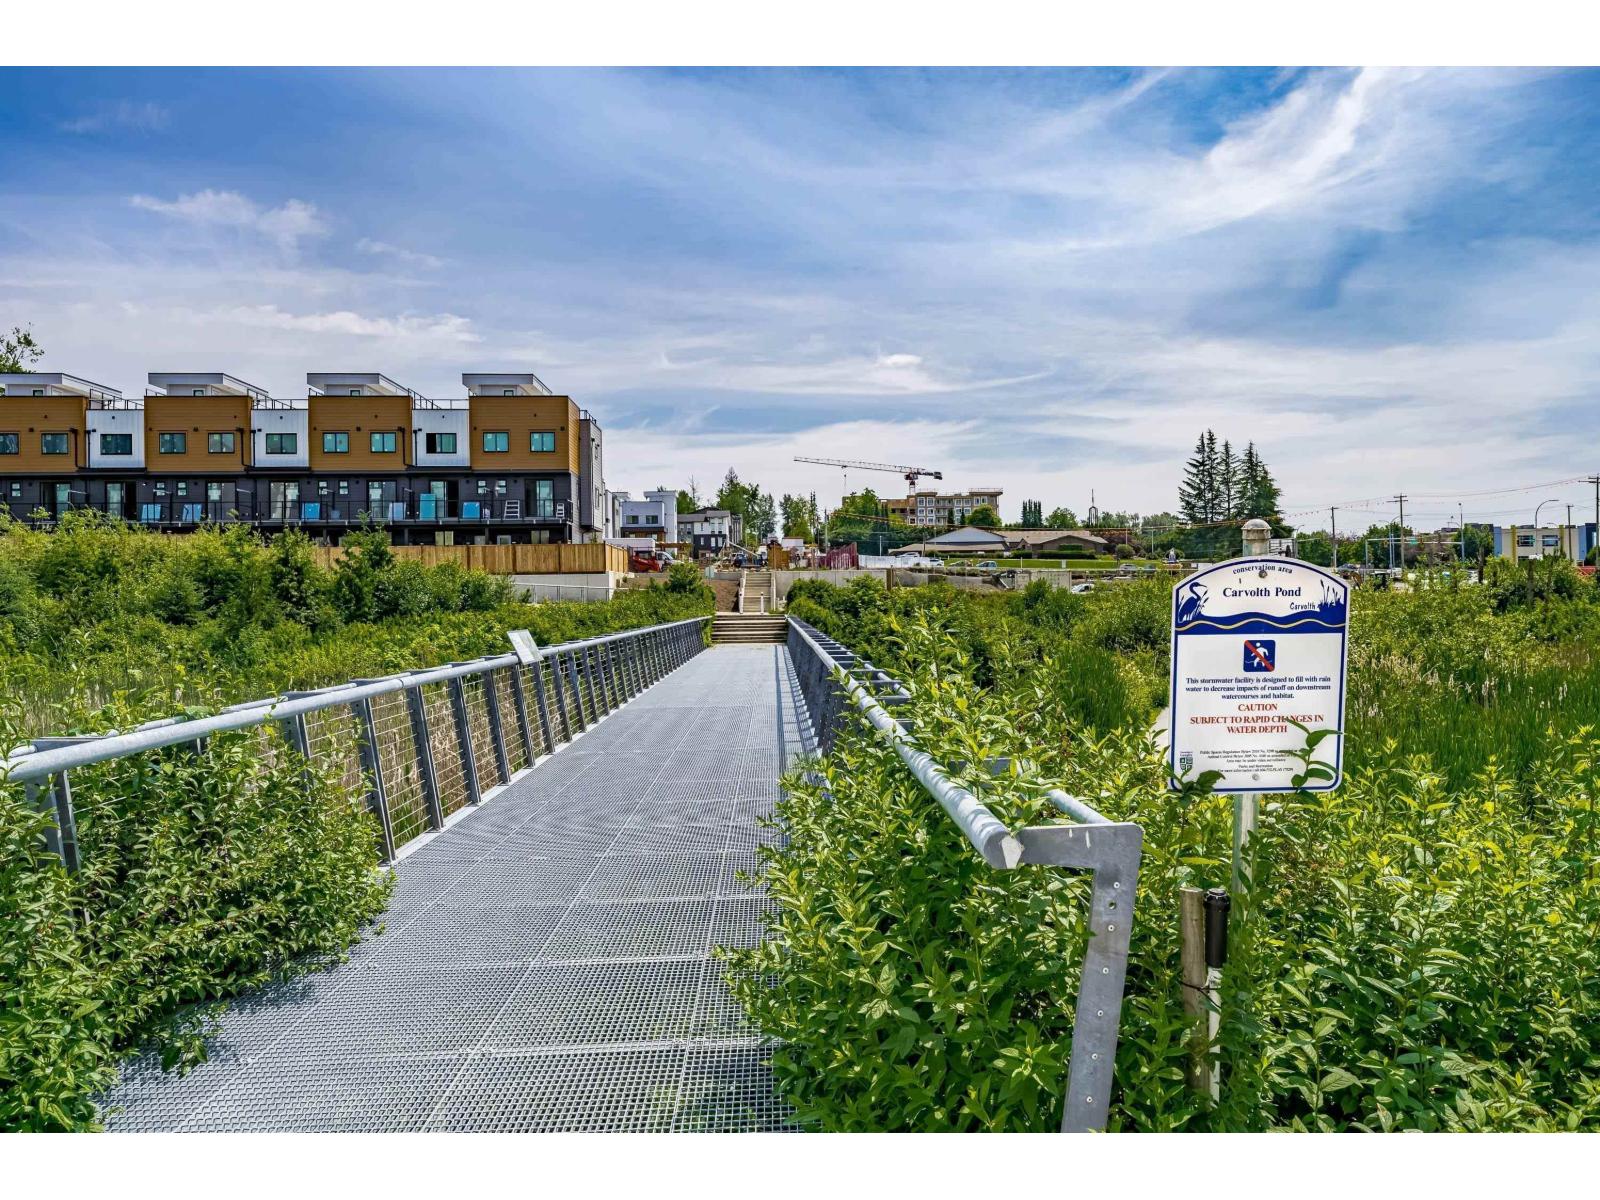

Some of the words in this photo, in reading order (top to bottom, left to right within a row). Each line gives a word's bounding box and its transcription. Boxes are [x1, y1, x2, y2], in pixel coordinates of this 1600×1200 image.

[1232, 564, 1276, 574] conservation
[1277, 566, 1293, 574] area
[1222, 587, 1271, 598] Carvolth
[1275, 586, 1301, 597] Pond
[1289, 602, 1316, 610] Carvolth
[1234, 677, 1254, 685] facility
[1262, 676, 1287, 684] designed
[1236, 685, 1259, 693] impacts
[1238, 703, 1278, 712] CAUTION
[1190, 716, 1227, 725] SUBJECT
[1230, 716, 1242, 724] TO
[1243, 715, 1270, 724] RAPID
[1314, 714, 1324, 722] IN
[1227, 725, 1257, 734] WATER
[1258, 725, 1287, 733] DEPTH
